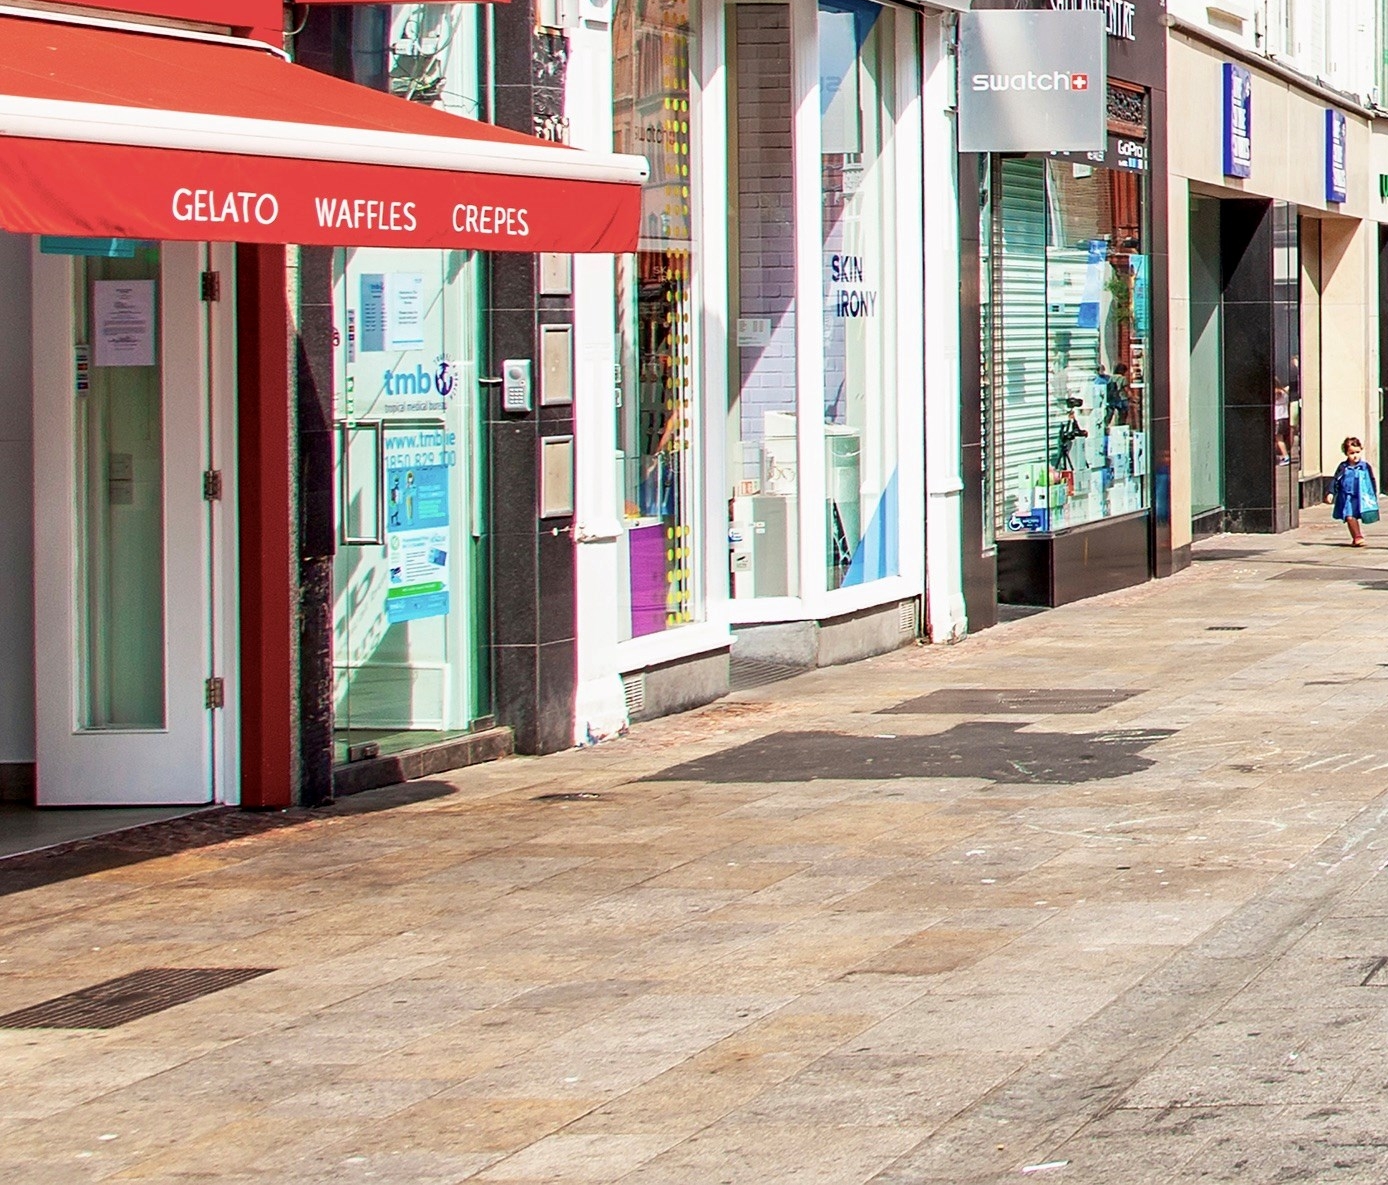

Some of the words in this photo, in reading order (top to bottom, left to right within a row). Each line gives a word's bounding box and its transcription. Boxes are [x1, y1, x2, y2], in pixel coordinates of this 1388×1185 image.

[971, 70, 1070, 92] swatch
[1117, 139, 1144, 157] GoPro
[171, 187, 279, 226] GELATO
[314, 196, 417, 232] WAFFLES
[451, 203, 530, 237] CREPES
[831, 254, 863, 283] SKIN
[836, 290, 878, 317] IRONY
[383, 364, 432, 396] tmb
